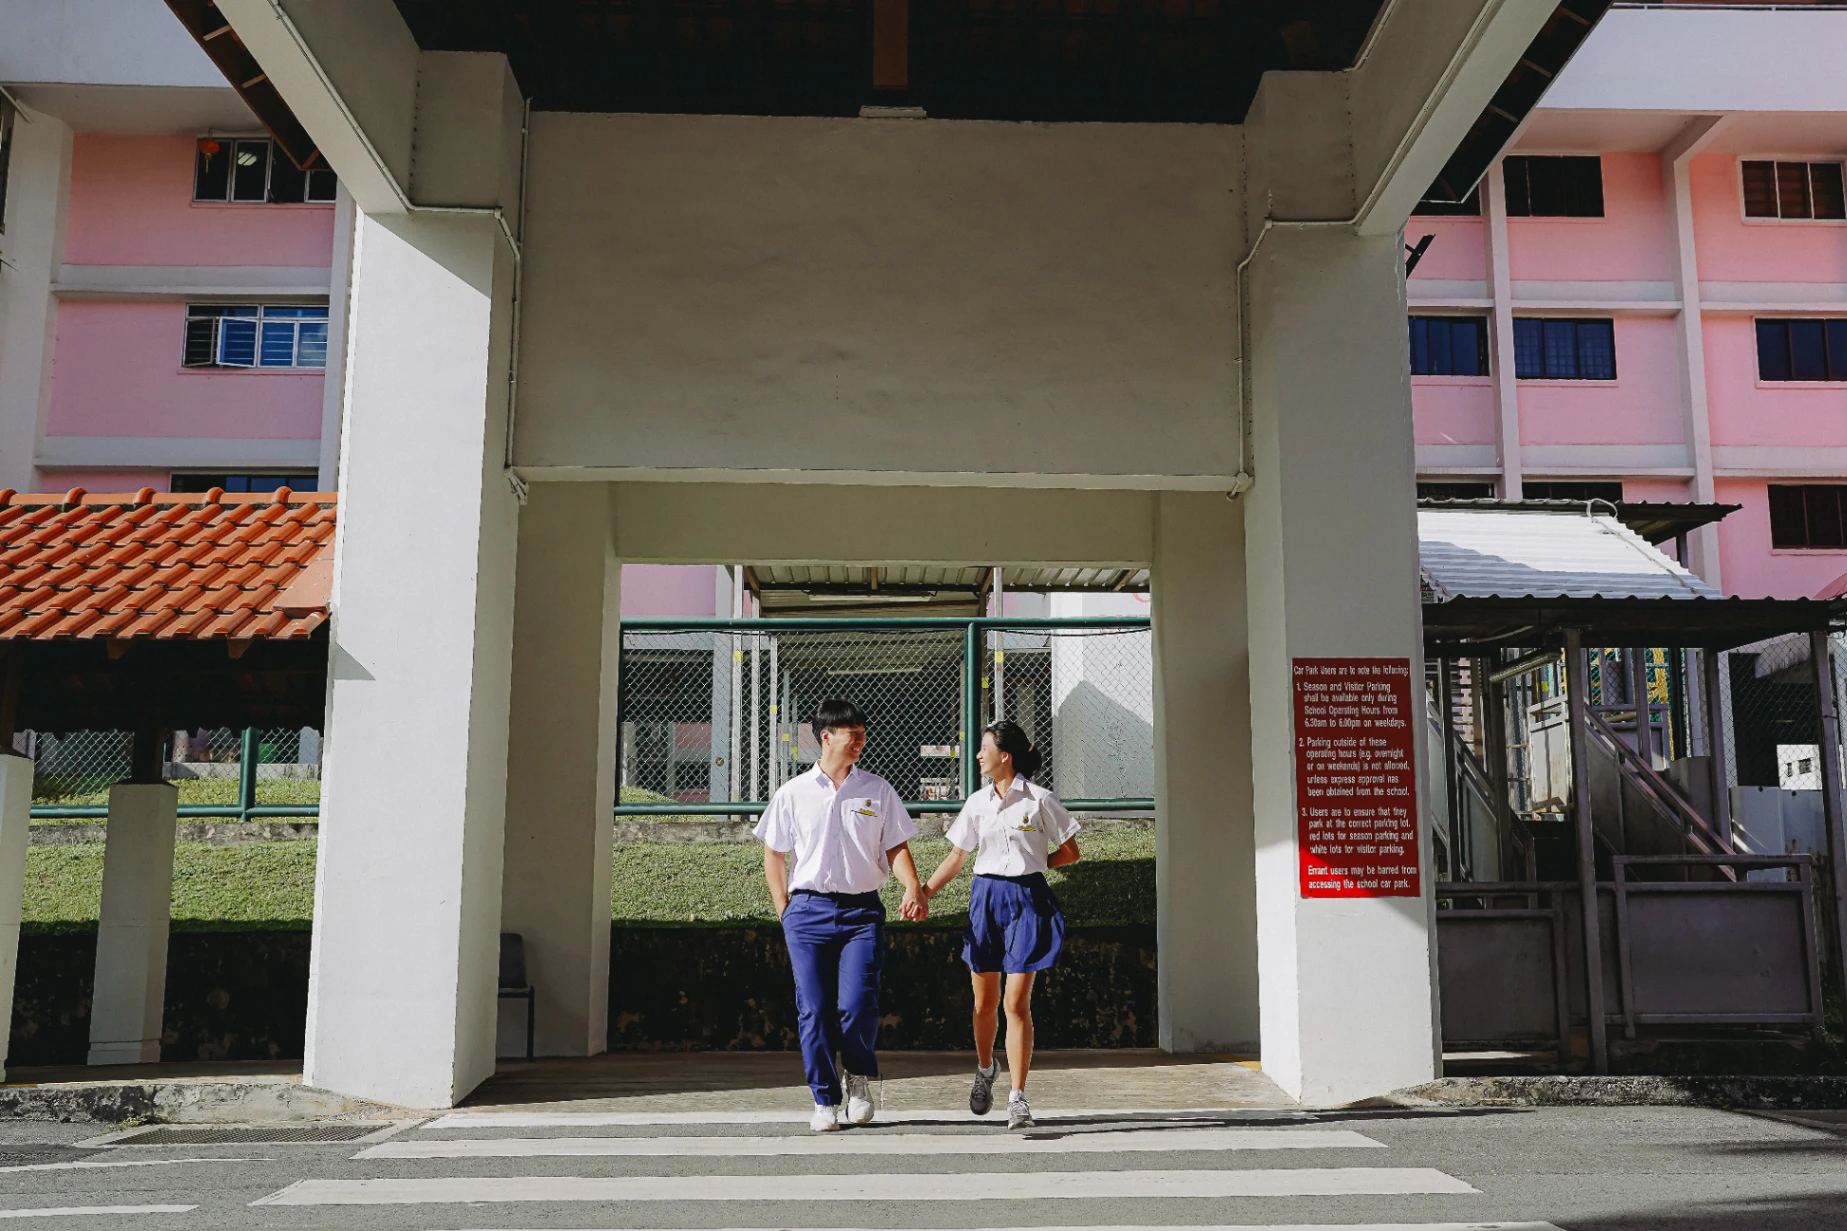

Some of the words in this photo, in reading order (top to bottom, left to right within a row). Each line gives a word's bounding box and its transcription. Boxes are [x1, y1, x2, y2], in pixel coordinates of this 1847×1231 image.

[1294, 666, 1303, 674] Car
[1306, 666, 1318, 674] Park
[1321, 666, 1336, 674] Users
[1350, 666, 1355, 674] to
[1372, 666, 1380, 674] the
[1304, 682, 1327, 691] Season
[1344, 682, 1363, 691] Visitor
[1367, 682, 1390, 693] Parking
[1304, 693, 1318, 702] shall
[1321, 694, 1328, 702] be
[1361, 693, 1374, 703] only
[1378, 693, 1397, 704] during
[1329, 706, 1358, 716] Operating
[1330, 719, 1336, 727] to
[1374, 718, 1406, 728] weekdays.
[1299, 738, 1304, 746] 2.
[1307, 737, 1330, 748] Parking
[1334, 738, 1356, 746] outside
[1360, 738, 1366, 746] of
[1369, 737, 1386, 746] these
[1306, 750, 1336, 760] operating
[1375, 748, 1403, 759] overnight
[1372, 761, 1381, 770] not
[1307, 775, 1327, 783] unless
[1331, 775, 1355, 784] express
[1358, 774, 1384, 785] approval
[1388, 774, 1399, 783] has
[1307, 787, 1323, 796] been
[1326, 787, 1353, 796] obtained
[1356, 787, 1371, 795] from
[1374, 787, 1384, 795] the
[1387, 787, 1409, 795] school.
[1302, 808, 1307, 816] 3.
[1310, 808, 1328, 816] Users
[1378, 807, 1390, 816] that
[1393, 807, 1407, 818] they
[1309, 819, 1322, 830] park
[1336, 819, 1345, 828] the
[1349, 819, 1371, 827] correct
[1374, 819, 1398, 829] parking
[1310, 832, 1320, 840] red
[1323, 832, 1334, 840] lots
[1338, 831, 1346, 840] for
[1375, 831, 1398, 842] parking
[1401, 831, 1413, 839] and
[1310, 845, 1327, 854] white
[1330, 845, 1341, 853] lots
[1345, 845, 1353, 853] for
[1357, 844, 1376, 853] visitor
[1308, 865, 1328, 875] Errant
[1351, 867, 1363, 876] may
[1367, 866, 1375, 874] be
[1378, 866, 1399, 874] barred
[1401, 865, 1417, 874] from
[1309, 880, 1340, 890] accessing
[1344, 880, 1354, 888] the
[1357, 879, 1378, 888] school
[1394, 880, 1410, 889] park.
